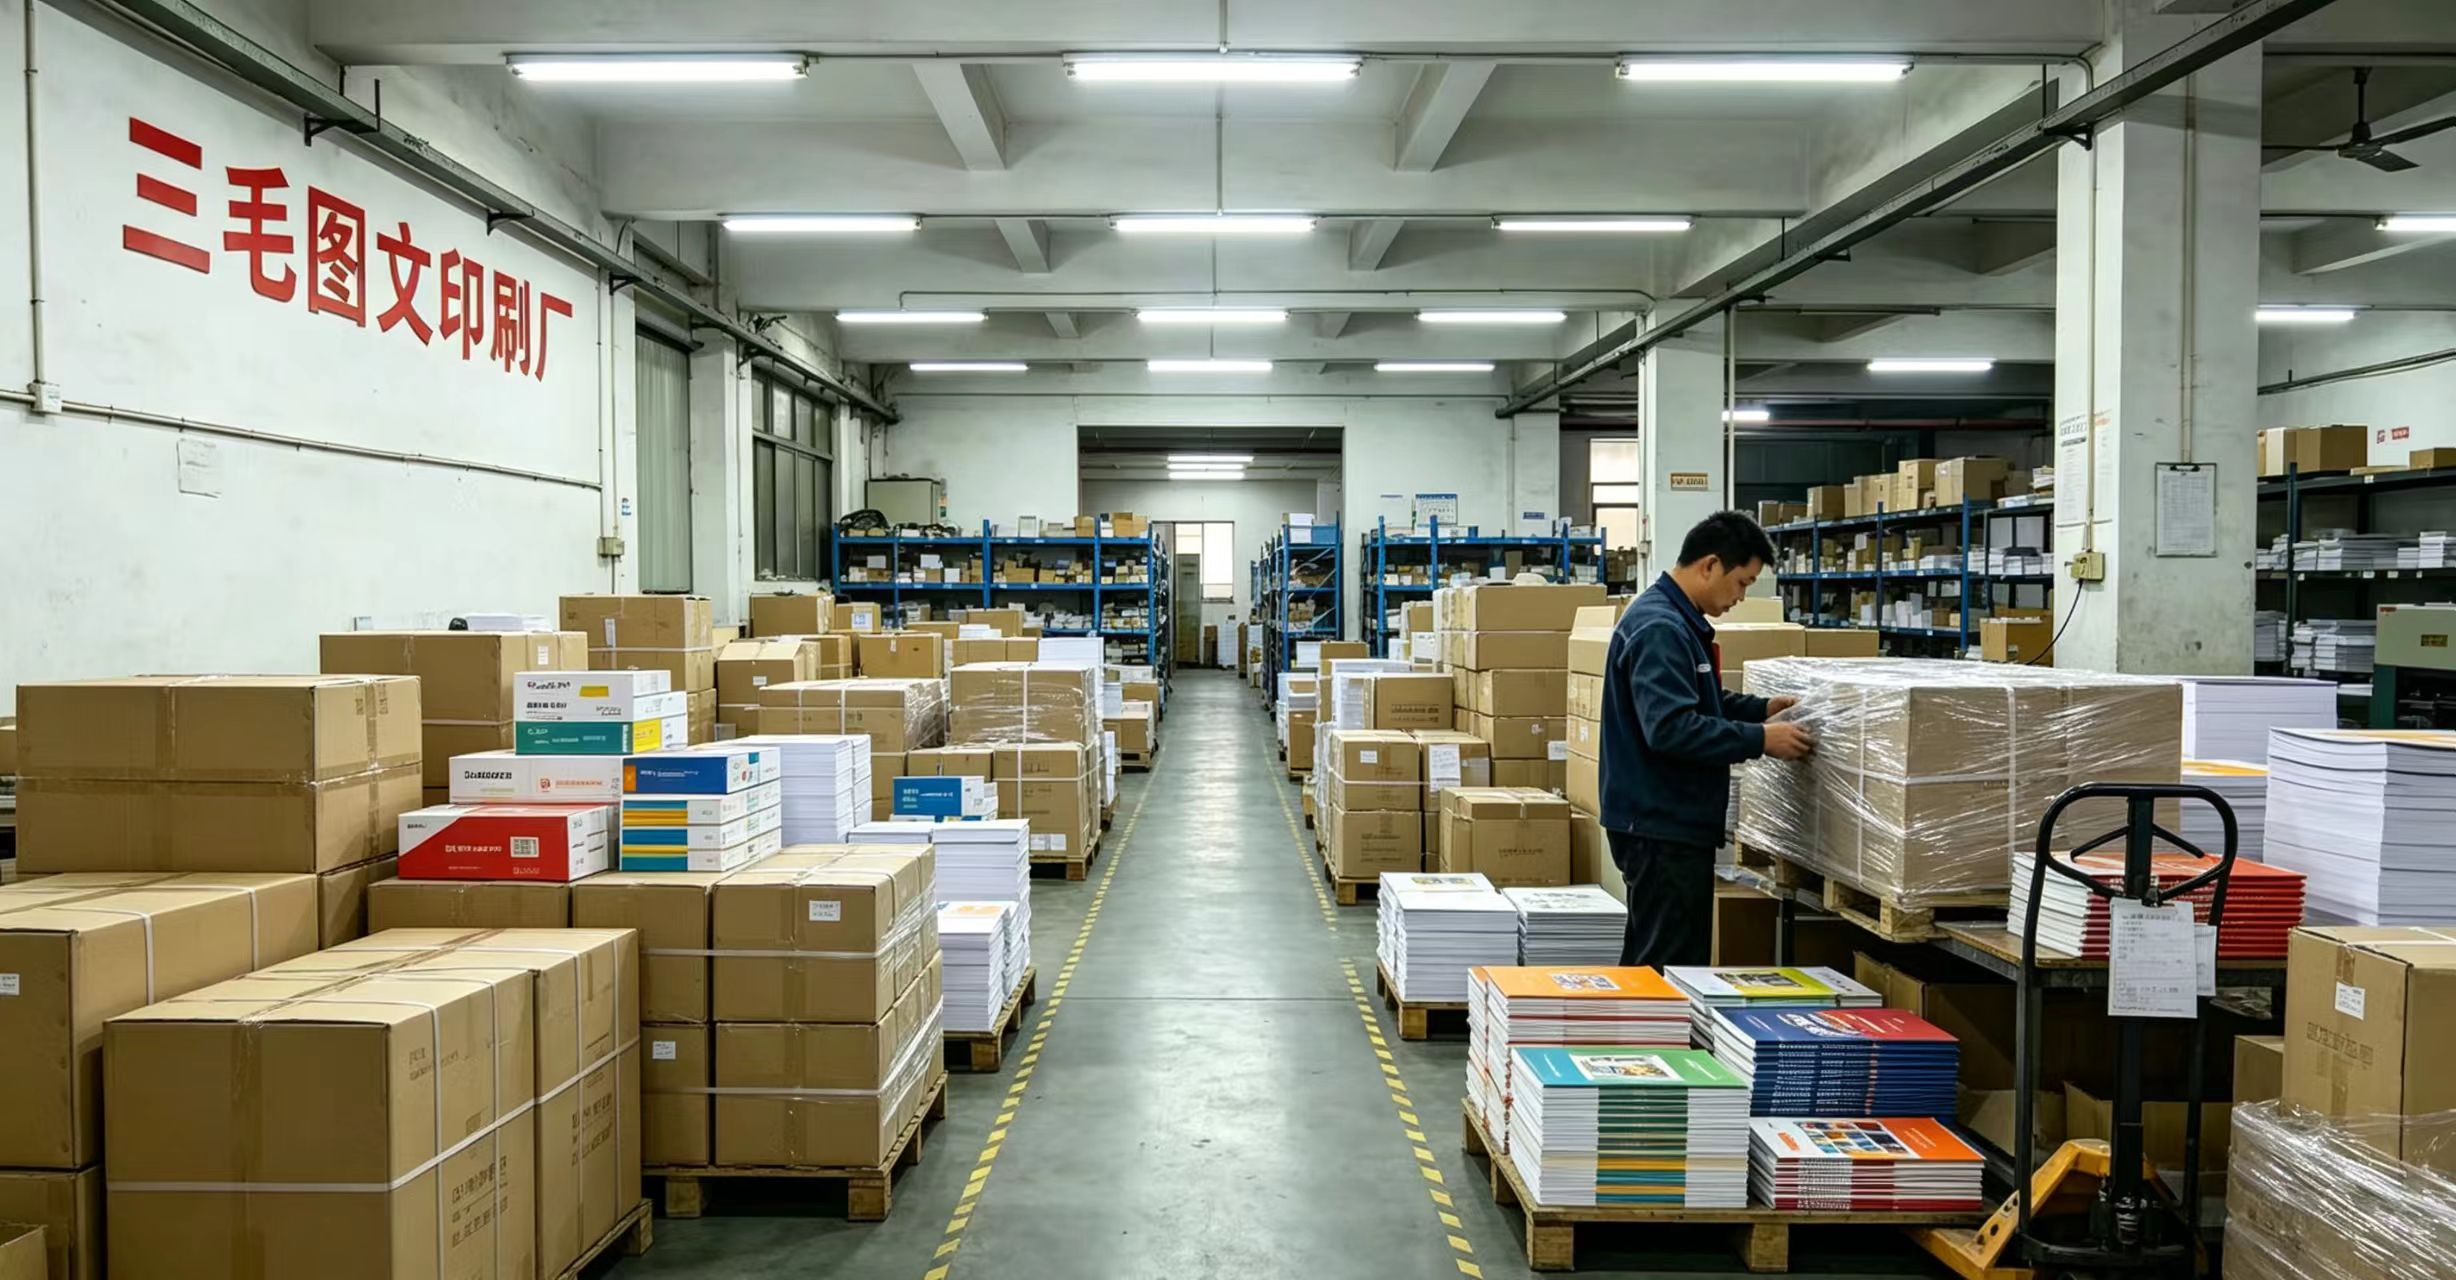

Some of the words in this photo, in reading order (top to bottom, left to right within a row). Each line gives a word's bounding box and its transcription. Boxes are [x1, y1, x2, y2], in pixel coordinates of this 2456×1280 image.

[122, 116, 573, 381] 三毛图文印刷厂
